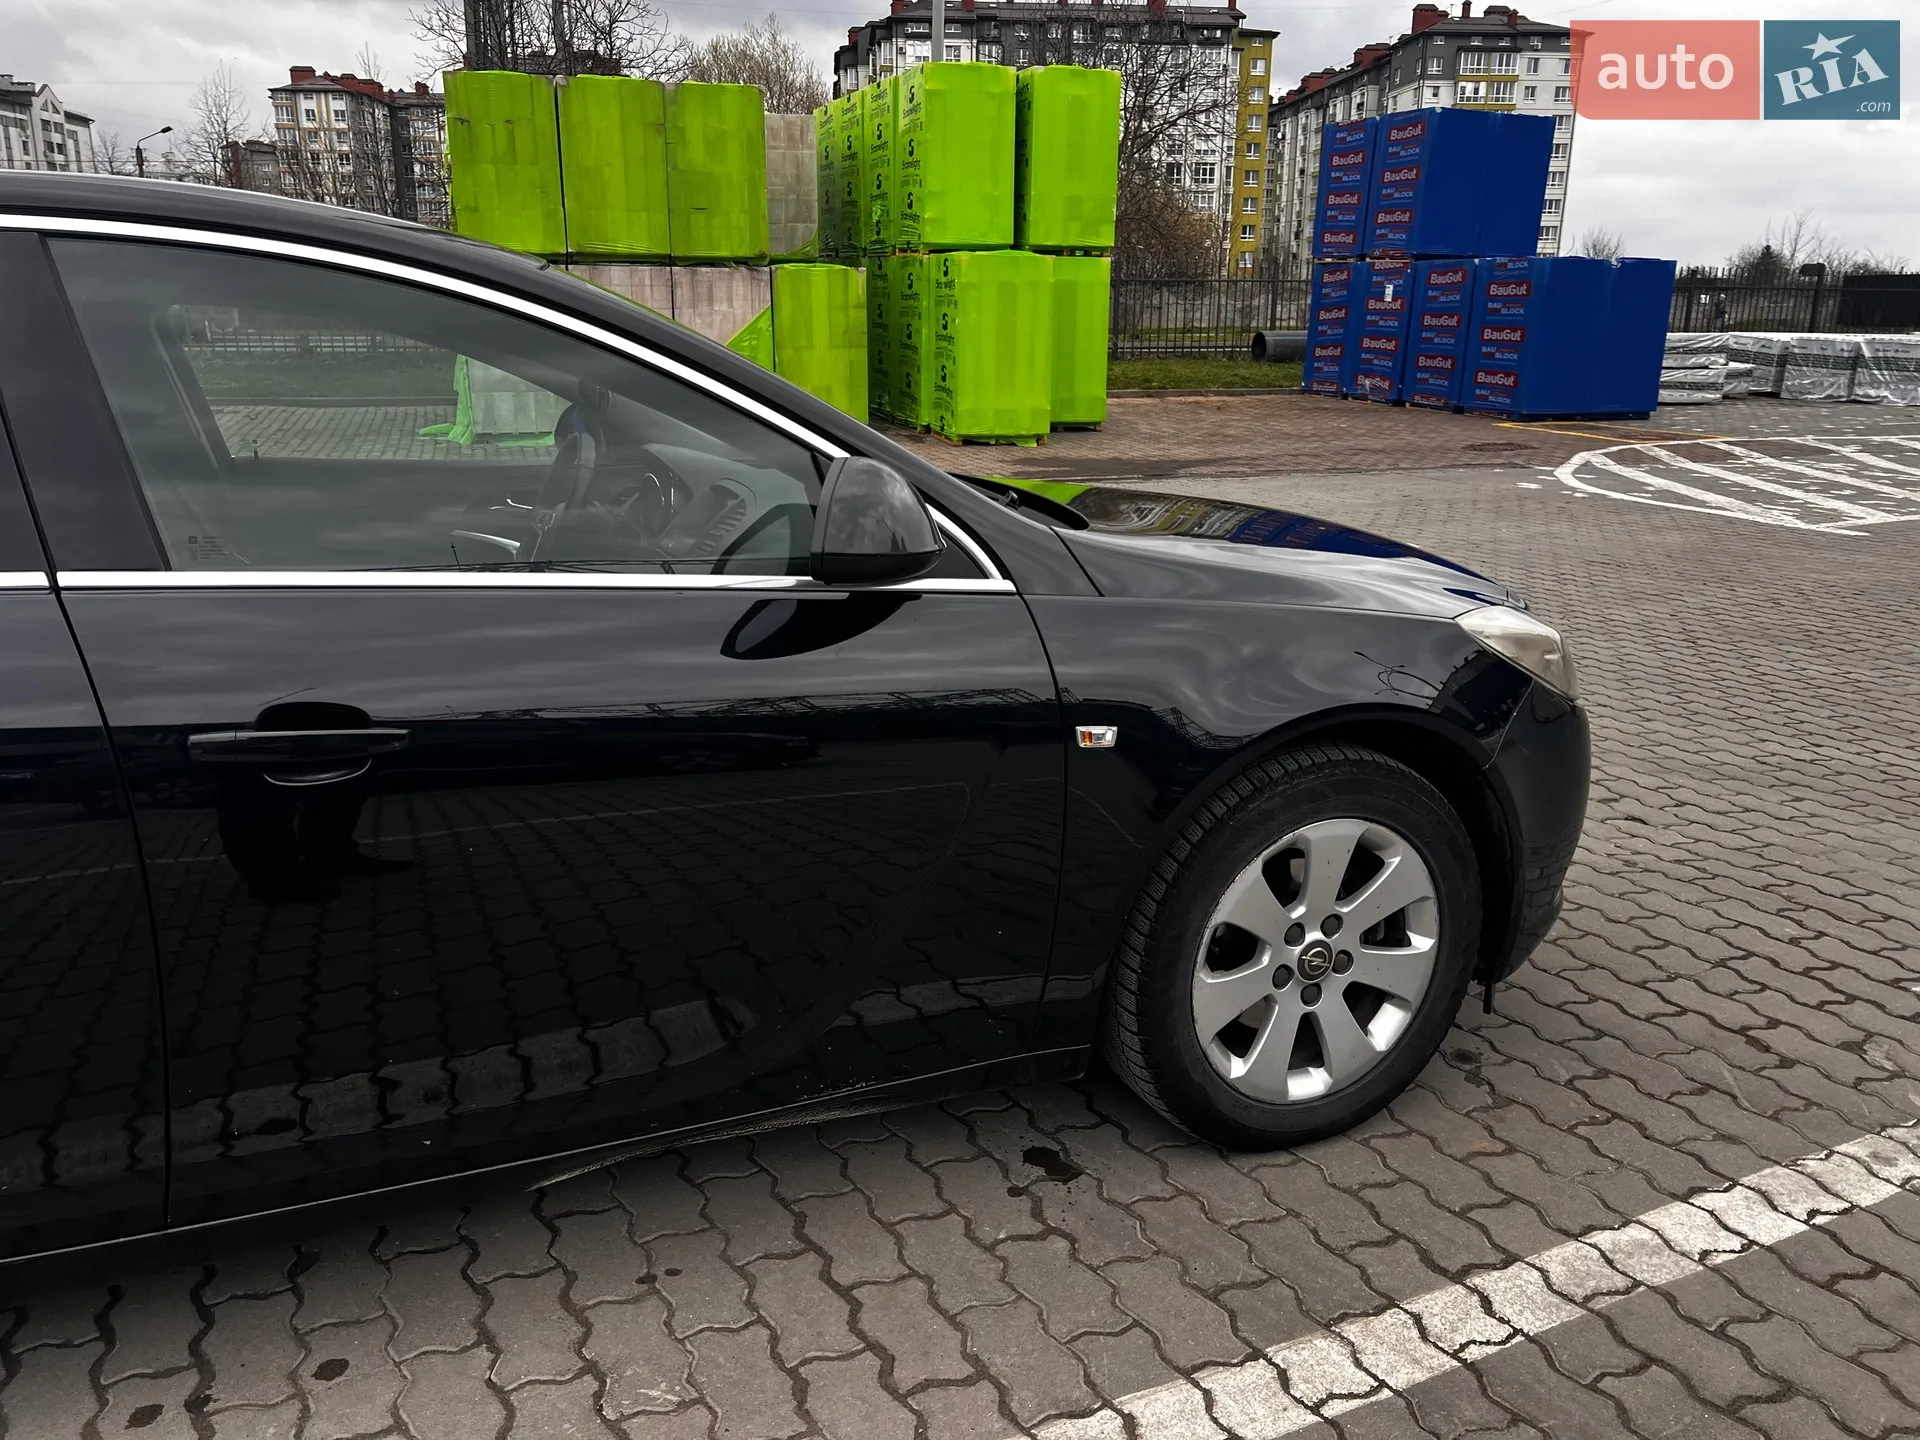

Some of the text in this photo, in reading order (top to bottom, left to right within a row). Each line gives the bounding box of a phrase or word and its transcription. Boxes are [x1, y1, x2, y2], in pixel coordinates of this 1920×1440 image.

[1390, 123, 1422, 141] BauGut
[1400, 147, 1420, 156] BLOCK
[1332, 152, 1363, 166] BauGut
[1383, 168, 1417, 182] BauGut
[1328, 193, 1359, 205] BauGut
[1377, 211, 1410, 223] BauGut
[1324, 233, 1354, 243] BauGut
[1323, 270, 1348, 282] BauGut
[1430, 271, 1463, 284] BauGut
[1489, 283, 1527, 295] BauGut
[1439, 294, 1461, 302] BLOCK
[1368, 299, 1402, 310] BauGut
[1500, 306, 1525, 315] BLOCK
[1319, 308, 1346, 320] BauGut
[1424, 315, 1459, 327] BauGut
[1483, 328, 1522, 341] BauGut
[1362, 338, 1396, 351] BauGut
[1315, 346, 1341, 357] BauGut
[1494, 352, 1519, 360] BLOCK
[1373, 358, 1393, 367] BLOCK
[1418, 356, 1452, 369] BauGut
[1428, 378, 1449, 386] BLOCK
[1477, 372, 1515, 386] BauGut
[1475, 388, 1491, 396] BAU
[1488, 395, 1511, 404] BLOCK
